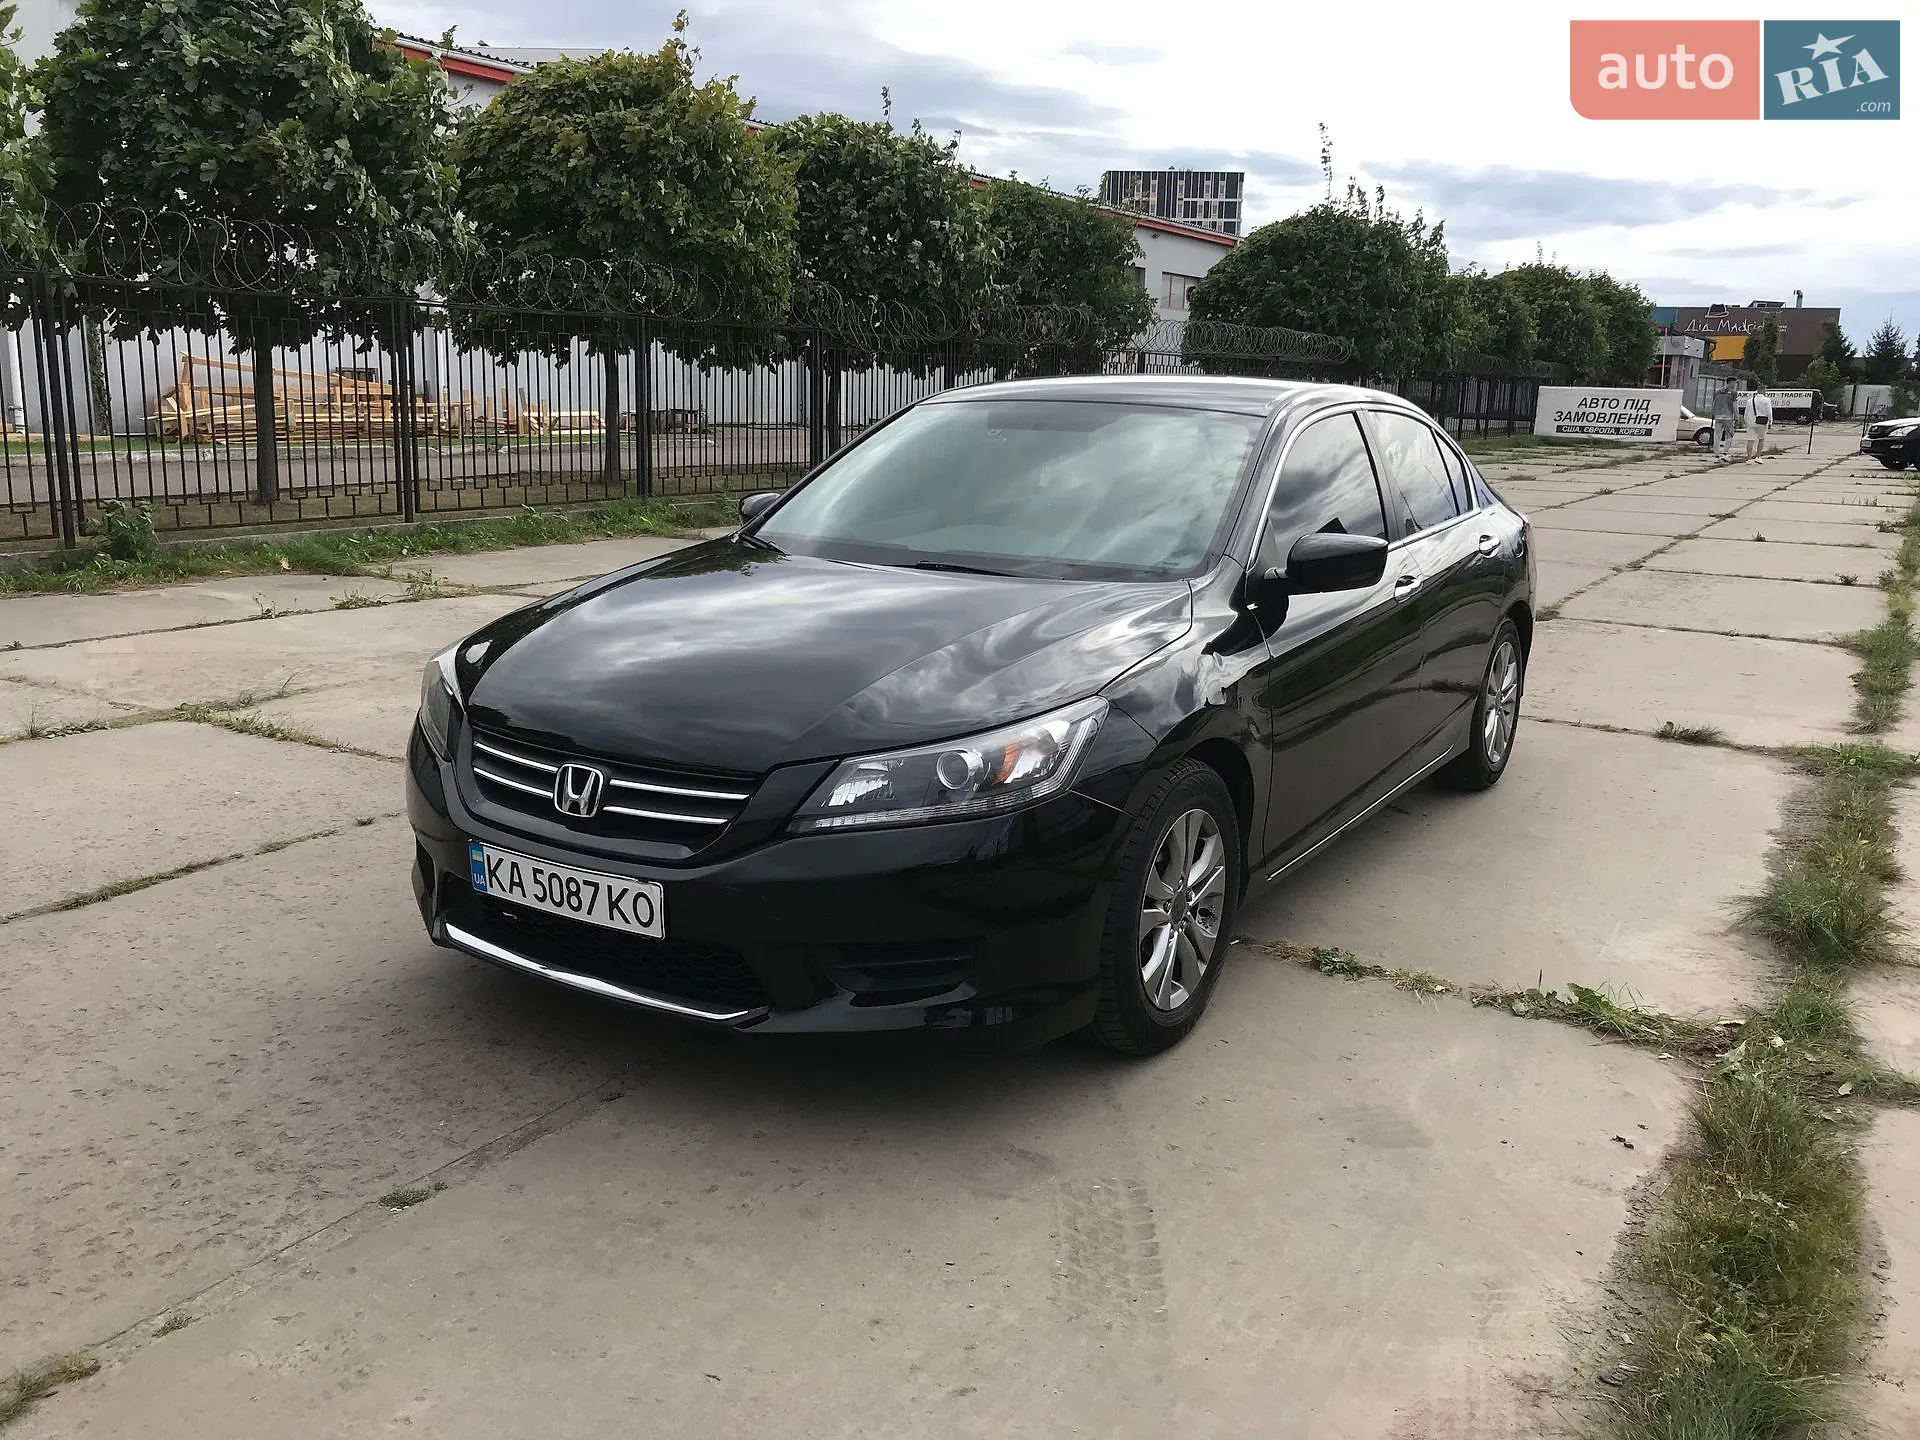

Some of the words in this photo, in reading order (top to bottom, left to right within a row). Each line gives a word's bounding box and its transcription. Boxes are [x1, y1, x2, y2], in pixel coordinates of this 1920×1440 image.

[1577, 397, 1620, 410] АВТО
[1623, 398, 1651, 413] ПІД
[1553, 411, 1661, 425] ЗАМОВЛЕННЯ
[1583, 427, 1617, 435] ЄВРОПА,
[473, 872, 486, 887] UA
[486, 853, 527, 899] KA
[532, 866, 600, 916] 5087
[606, 884, 655, 928] KO
